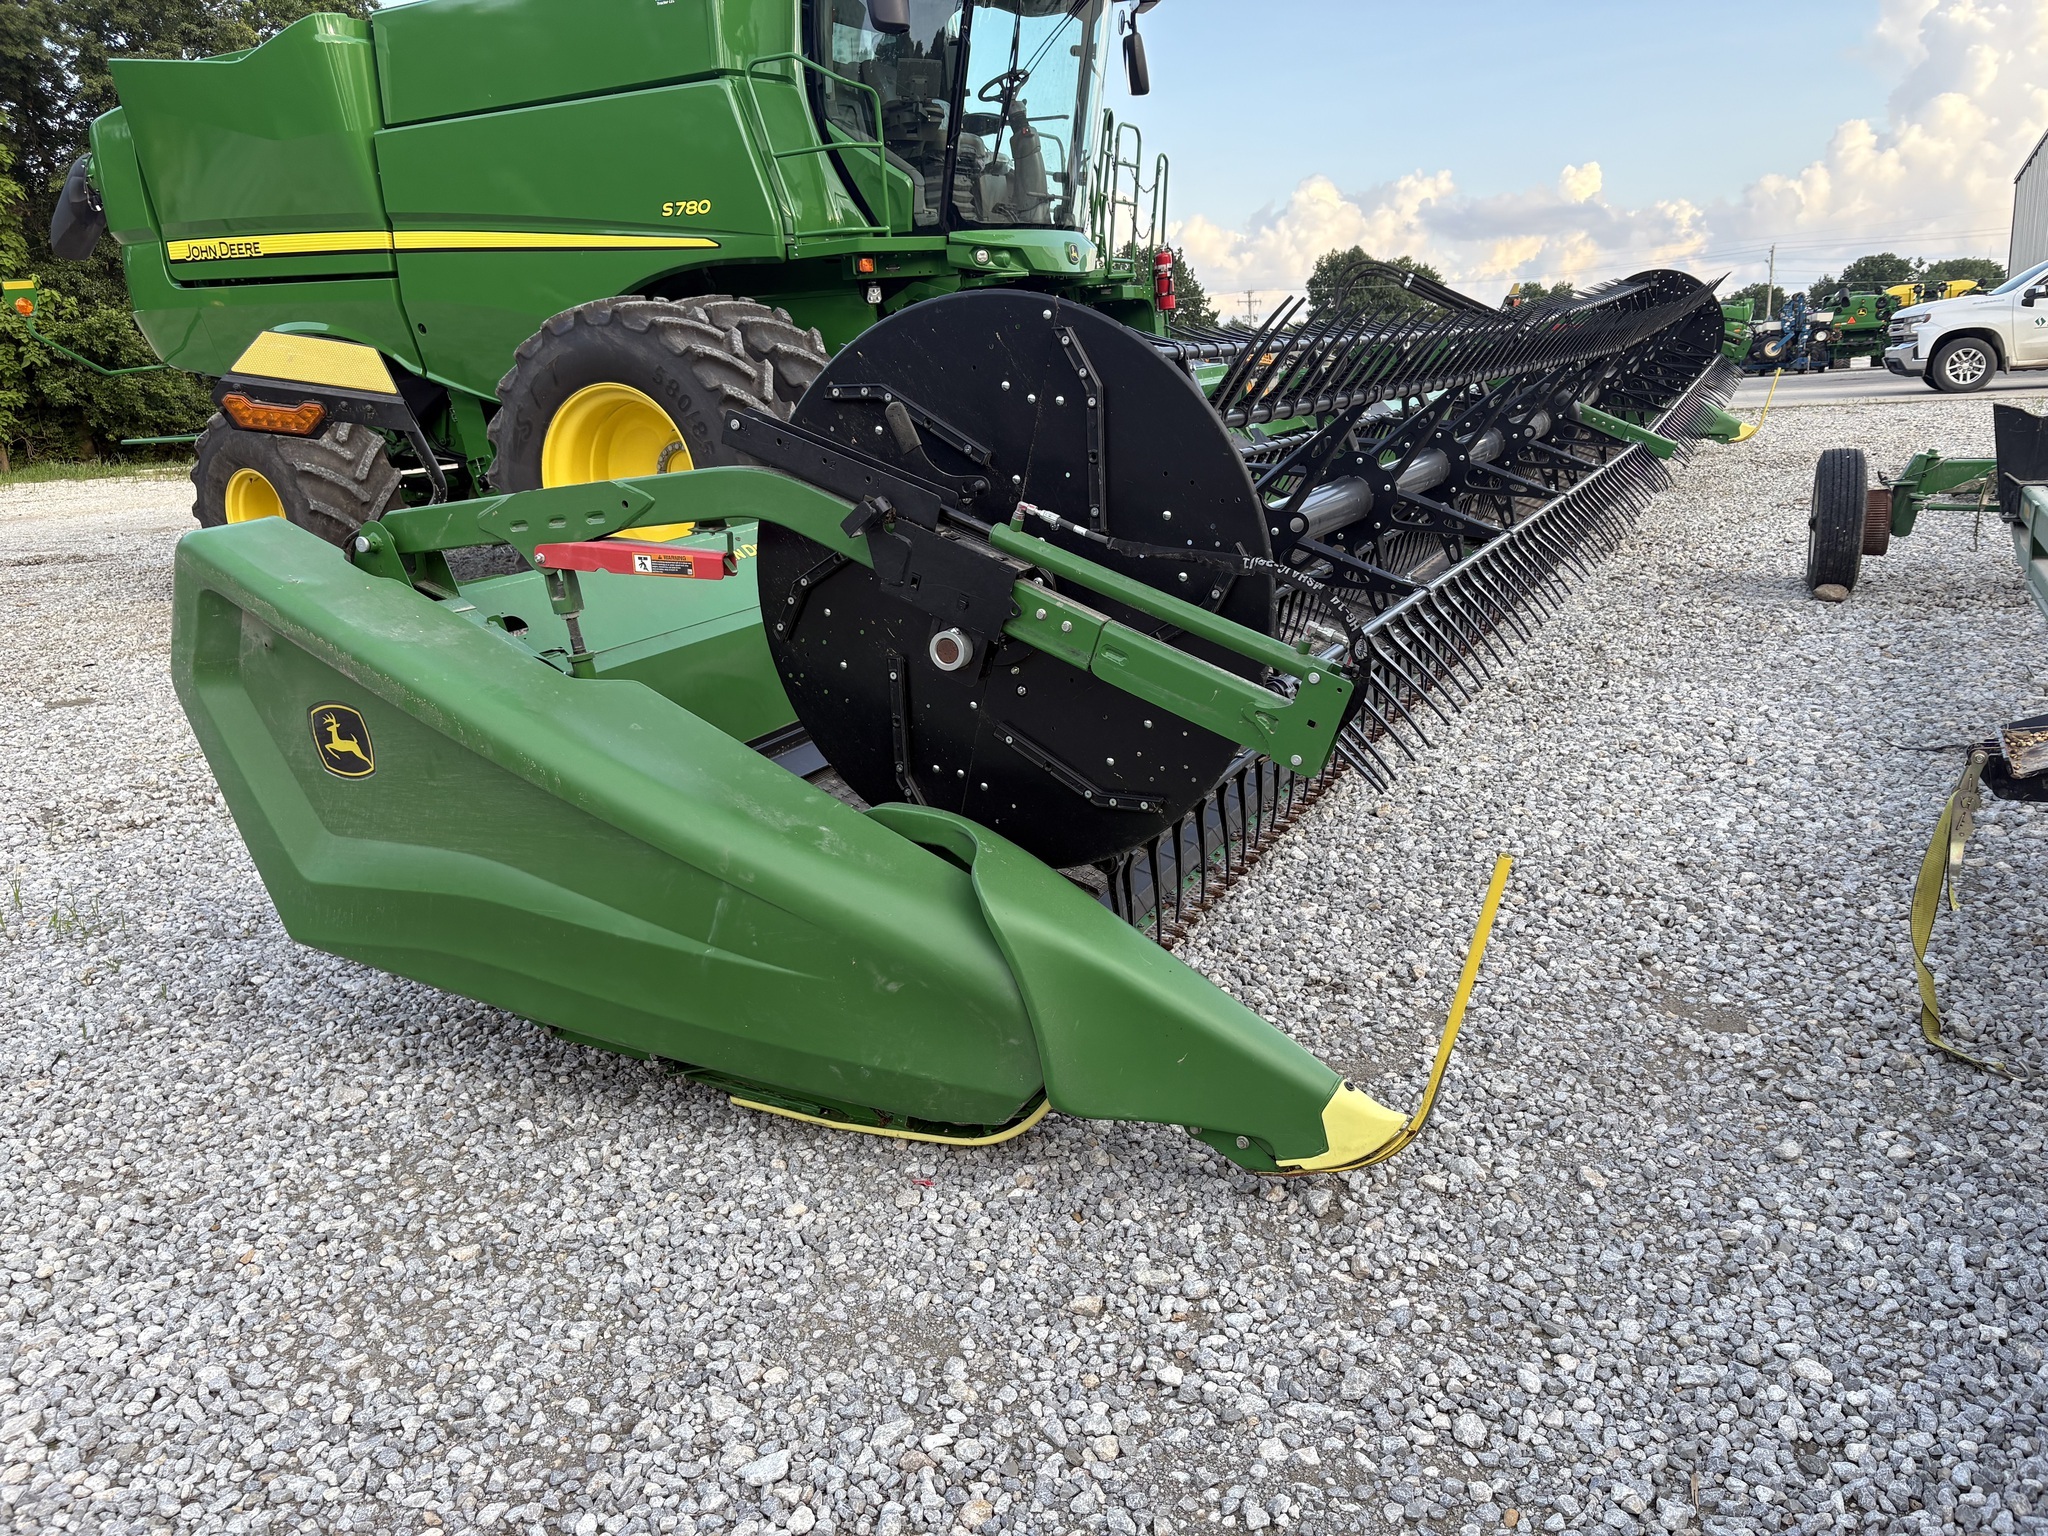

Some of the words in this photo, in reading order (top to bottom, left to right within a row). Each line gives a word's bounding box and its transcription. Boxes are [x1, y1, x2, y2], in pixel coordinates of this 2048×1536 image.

[661, 198, 712, 217] S780
[185, 243, 218, 259] JOHN
[218, 241, 262, 256] DEERE
[1292, 570, 1325, 590] MSHA
